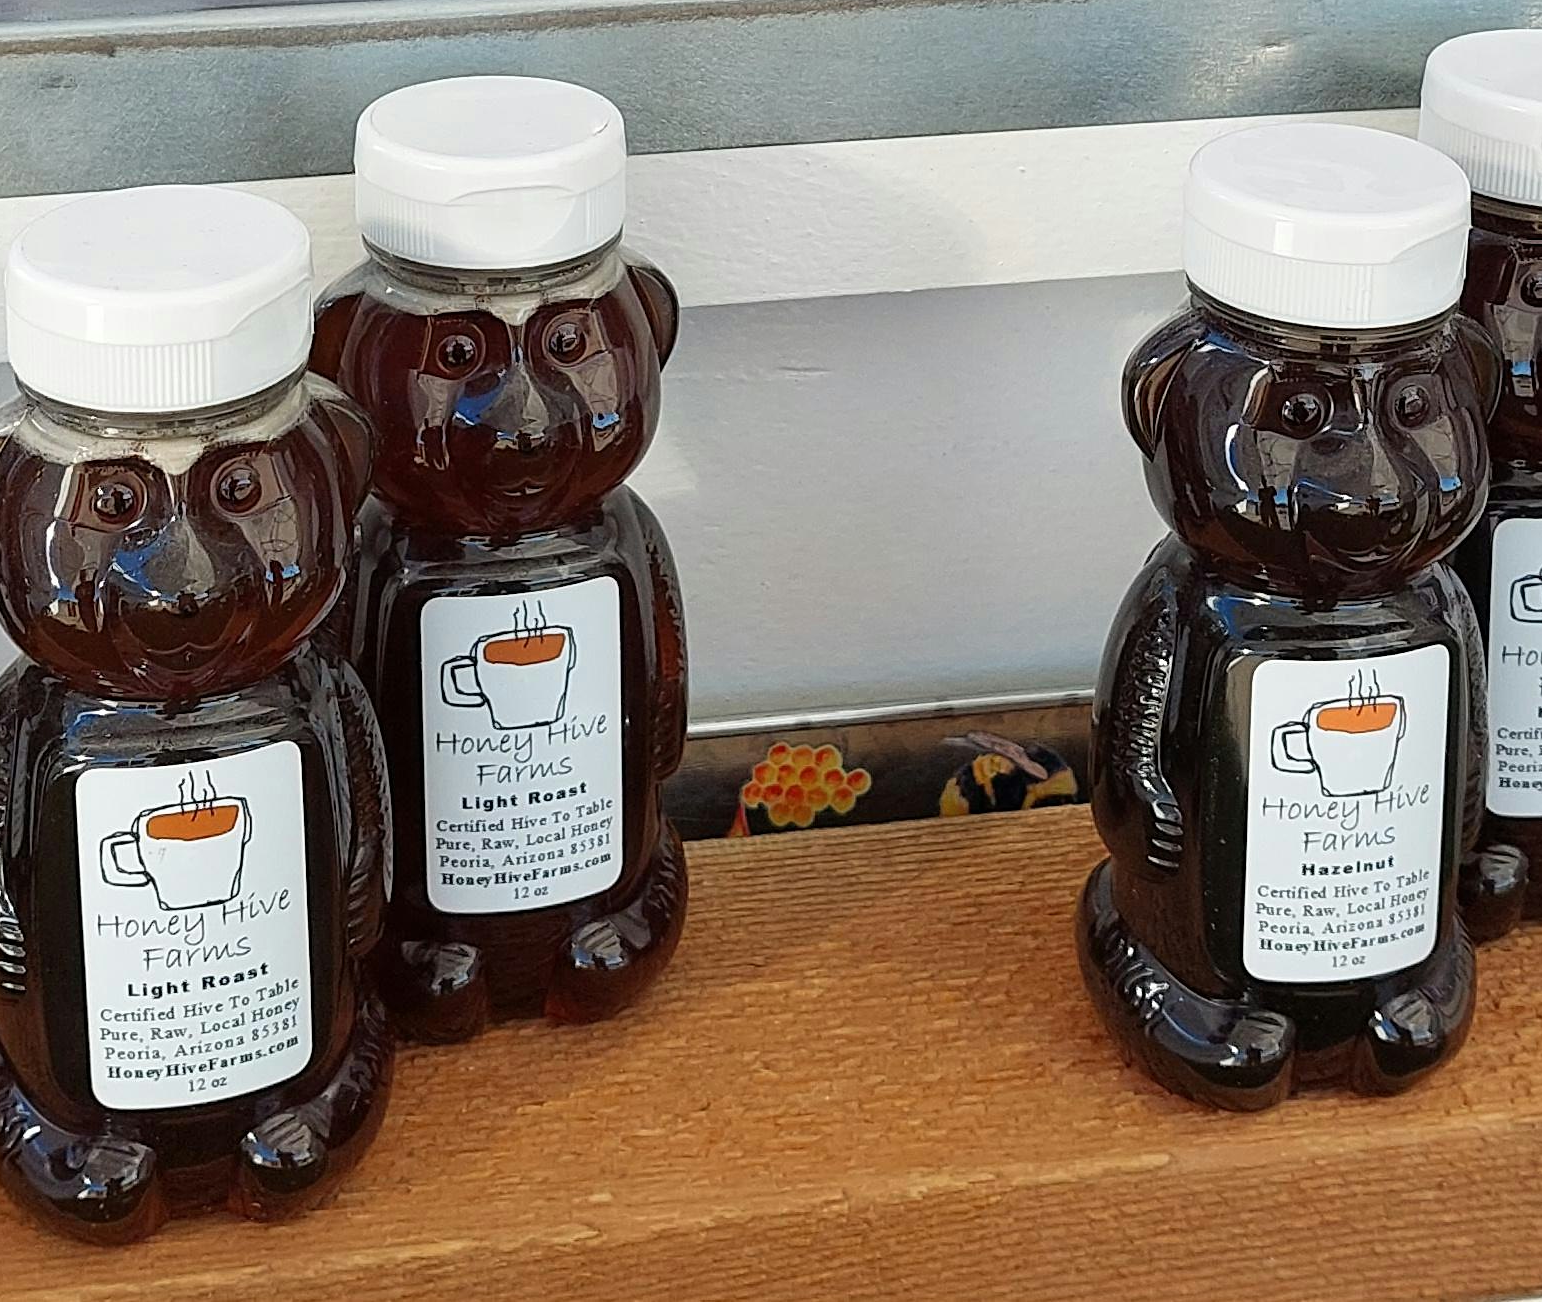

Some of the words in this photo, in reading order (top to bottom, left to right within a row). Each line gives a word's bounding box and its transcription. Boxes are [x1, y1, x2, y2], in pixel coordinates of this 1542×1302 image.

[437, 732, 533, 763] Honey
[548, 714, 607, 745] Hive
[477, 757, 572, 786] Farms
[462, 794, 517, 811] Light
[529, 782, 587, 804] Roast
[1263, 797, 1360, 830] Honey
[1375, 784, 1429, 813] Hive
[1303, 827, 1396, 852] Farms
[1302, 856, 1394, 876] Hazelnut
[98, 913, 204, 945] Honey
[222, 889, 291, 924] Hive
[1259, 921, 1314, 936] Peoria,
[1322, 920, 1383, 933] Arizona
[143, 936, 252, 971] Farms
[128, 980, 190, 998] Light
[202, 963, 269, 990] Roast
[100, 1028, 144, 1042] Pure,
[151, 1027, 193, 1040] Raw,
[201, 1012, 245, 1035] Local
[251, 997, 300, 1023] Honey
